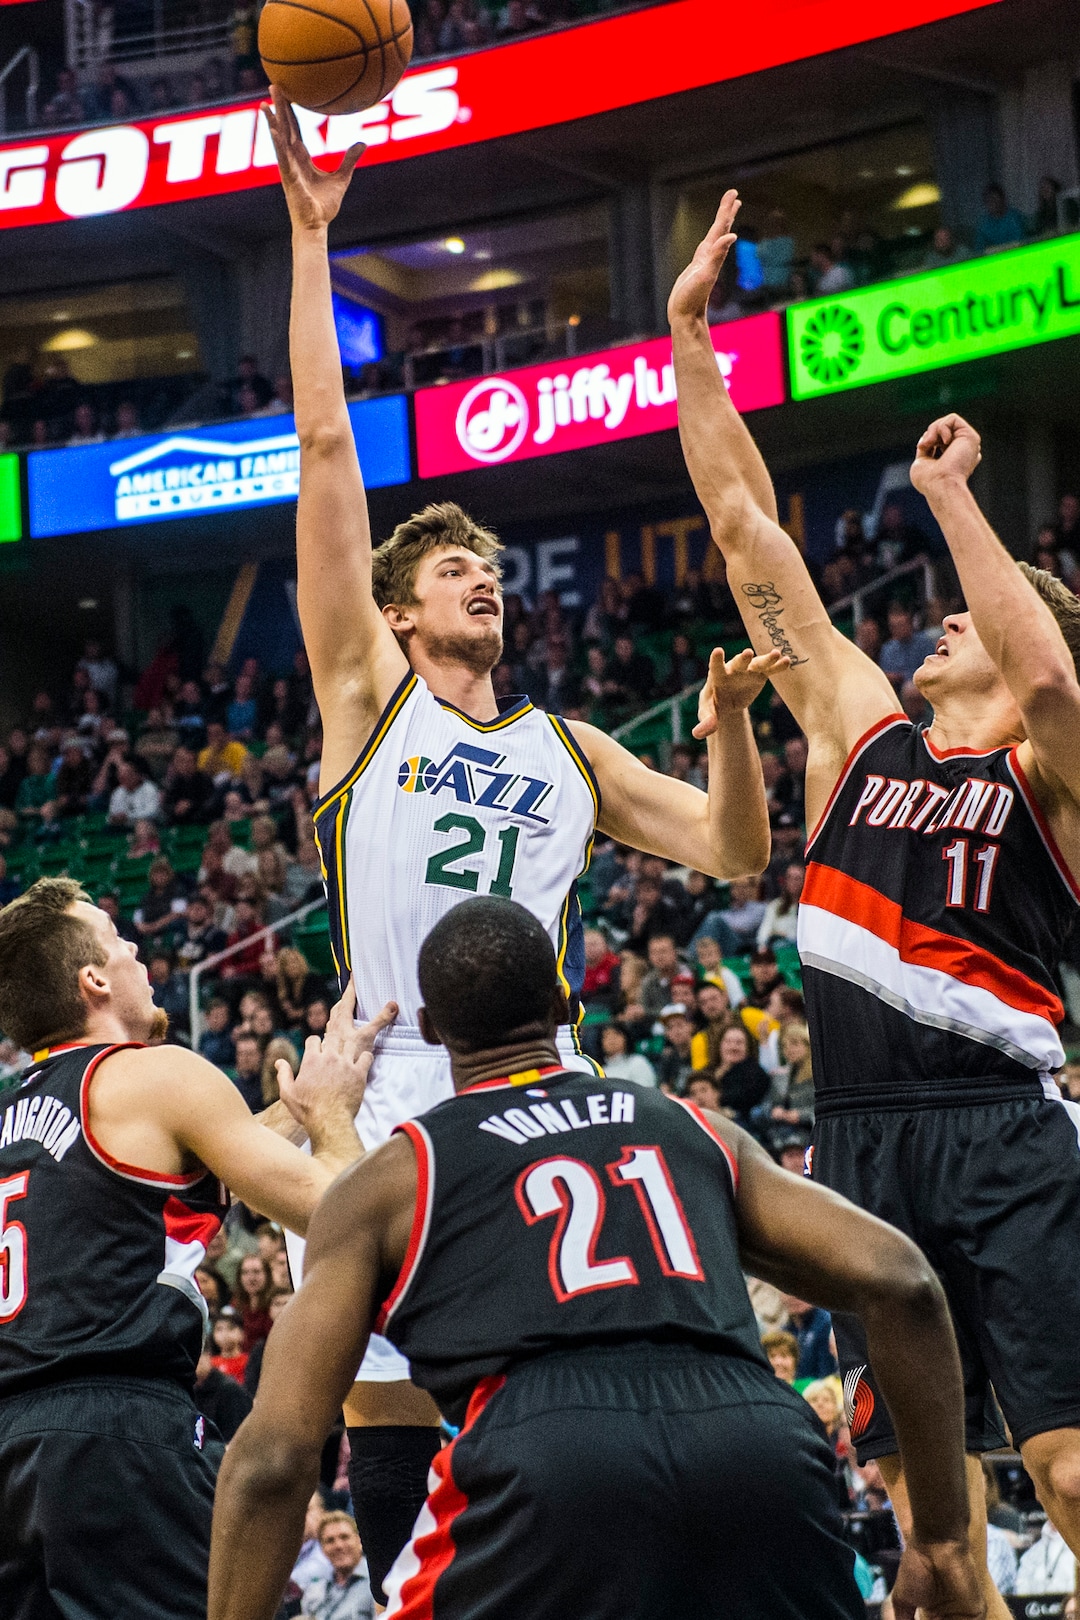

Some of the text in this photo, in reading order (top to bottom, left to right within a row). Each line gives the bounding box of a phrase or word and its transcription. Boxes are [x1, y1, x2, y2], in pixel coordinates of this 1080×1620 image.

[877, 264, 1080, 355] CenturyL
[115, 459, 236, 497] AMERICAN
[848, 774, 1014, 837] PORTLAND
[424, 811, 521, 900] 21
[942, 838, 1000, 914] 11
[0, 1095, 81, 1163] AUGHTON
[477, 1091, 635, 1145] VONLEH
[514, 1145, 706, 1303] 21
